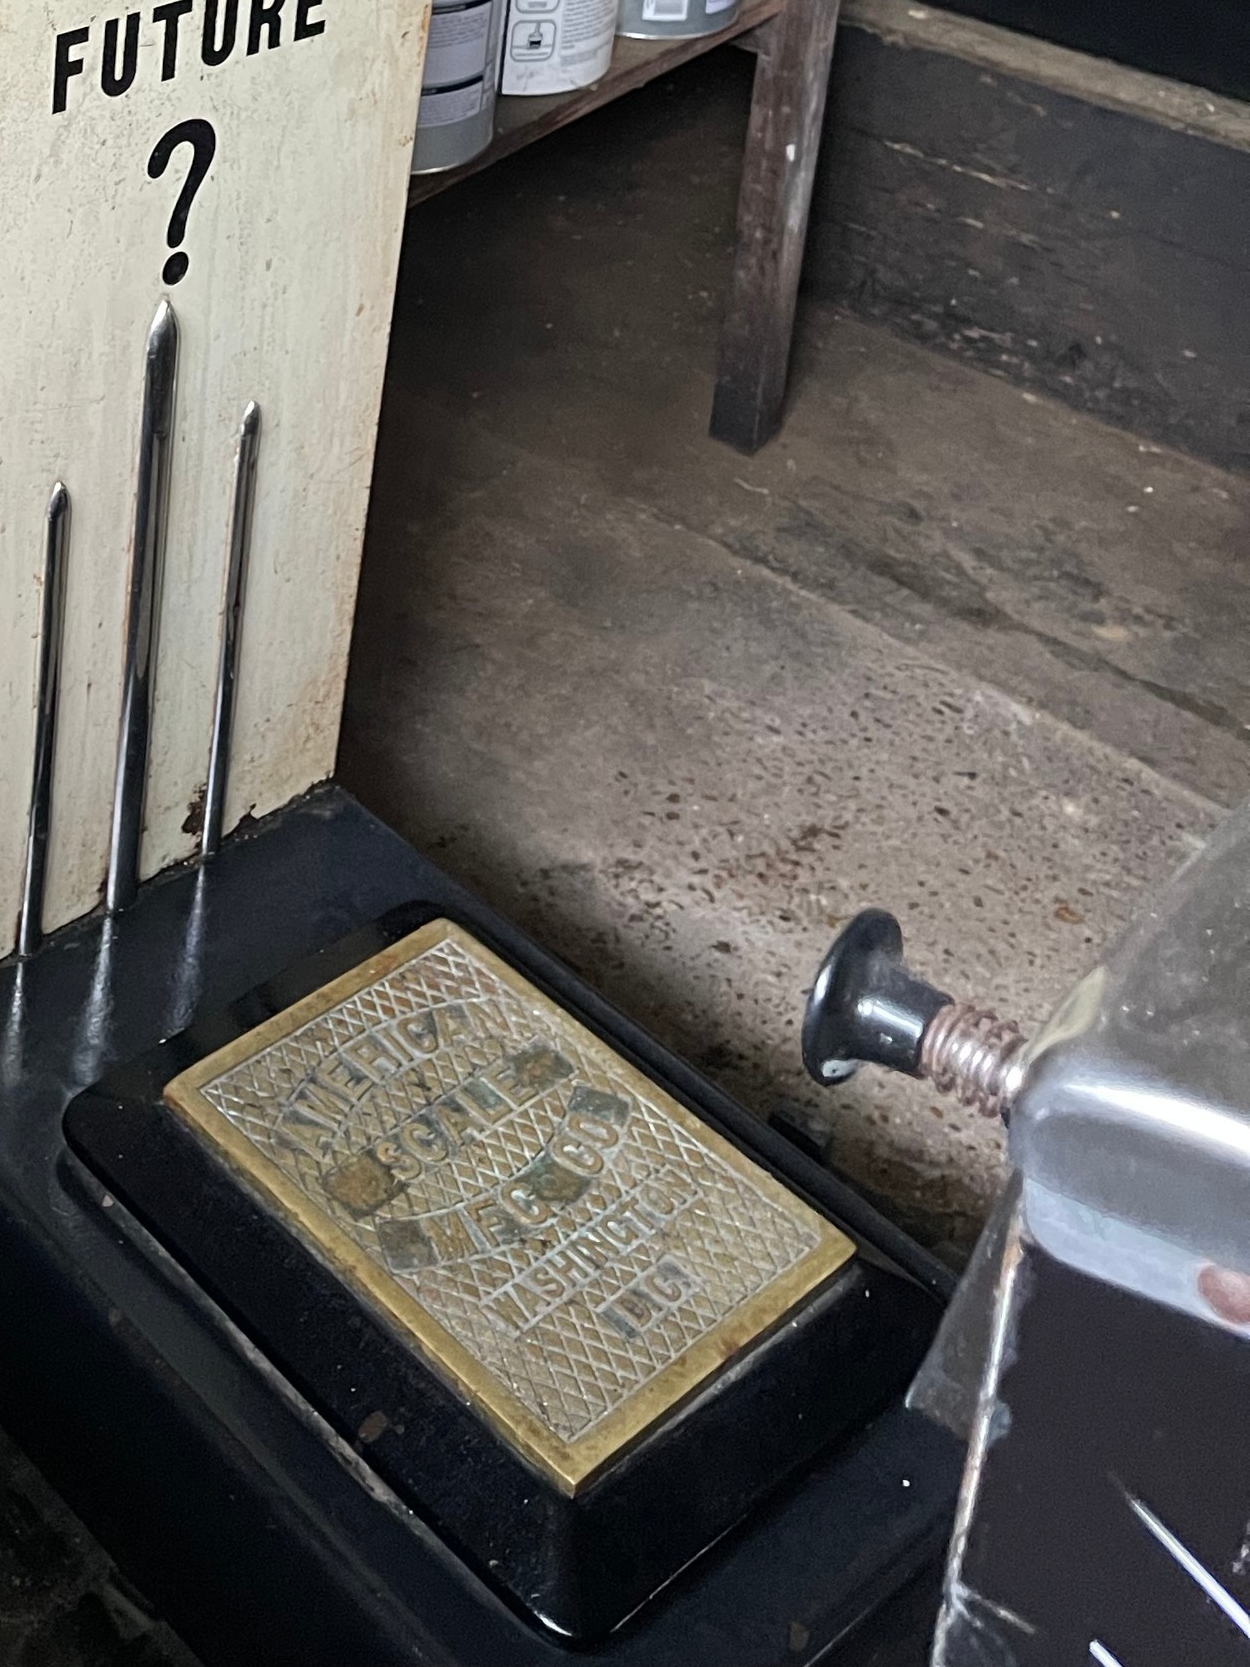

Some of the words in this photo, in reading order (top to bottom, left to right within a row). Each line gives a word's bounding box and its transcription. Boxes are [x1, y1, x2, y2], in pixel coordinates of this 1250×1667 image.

[147, 118, 216, 285] ?
[282, 999, 514, 1154] AMERICAN
[376, 1064, 540, 1181] SCALE
[490, 1170, 696, 1326] WASHINGTON
